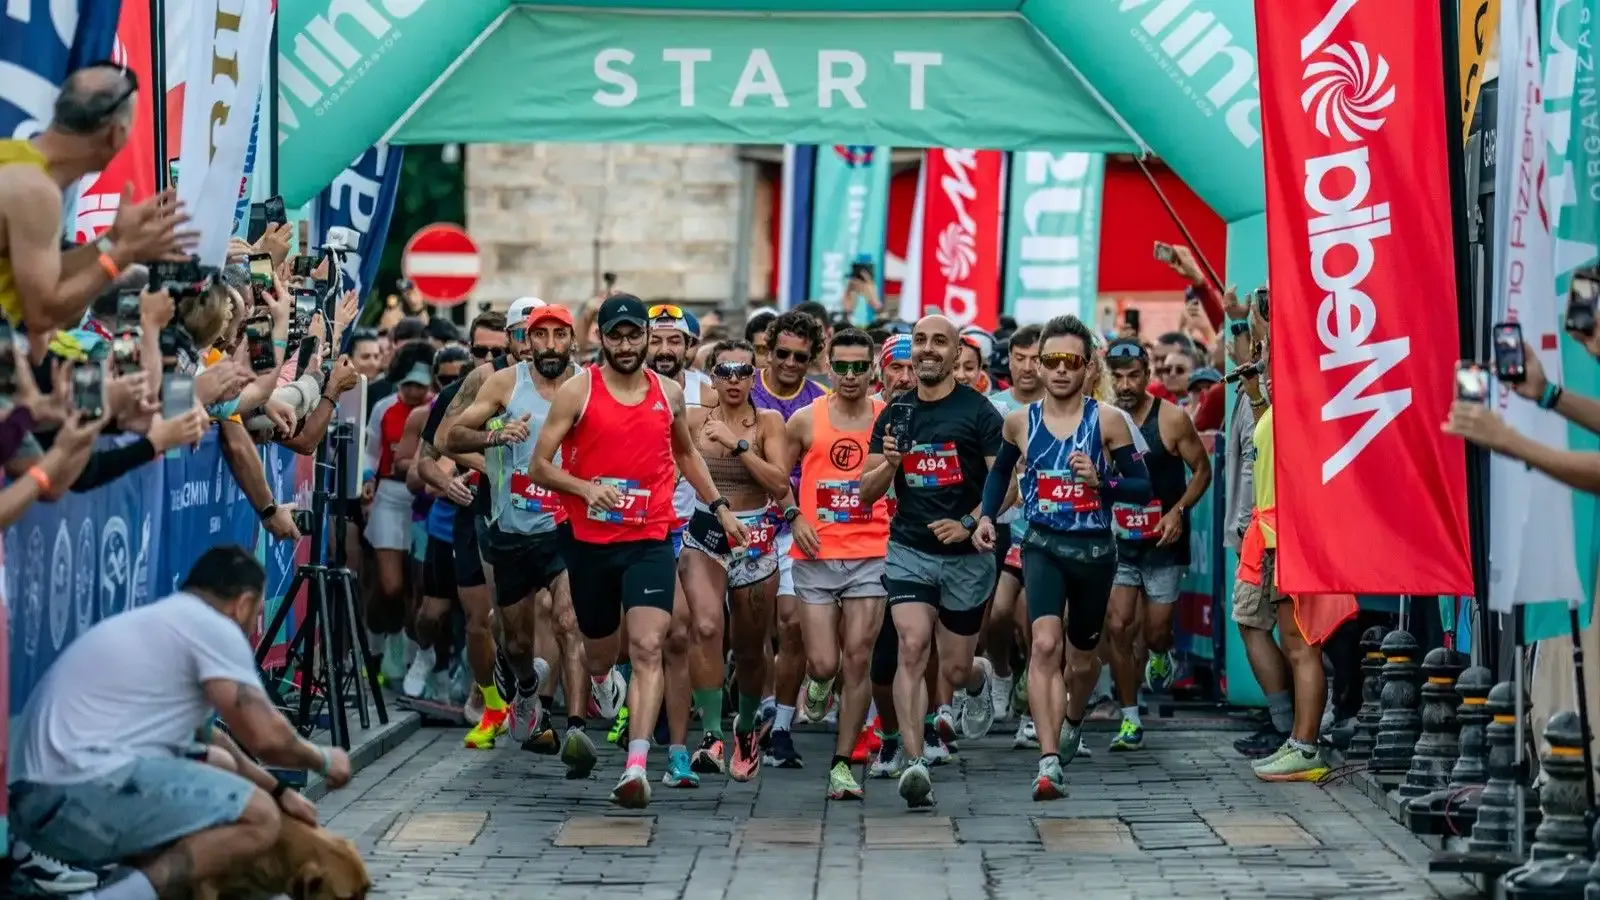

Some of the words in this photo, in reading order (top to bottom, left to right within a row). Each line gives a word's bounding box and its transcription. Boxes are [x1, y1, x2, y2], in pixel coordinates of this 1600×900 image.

[592, 48, 943, 110] START
[916, 457, 948, 472] 494
[1052, 484, 1085, 499] 475
[830, 495, 860, 509] 326
[1126, 514, 1149, 527] 231
[748, 529, 768, 544] 36
